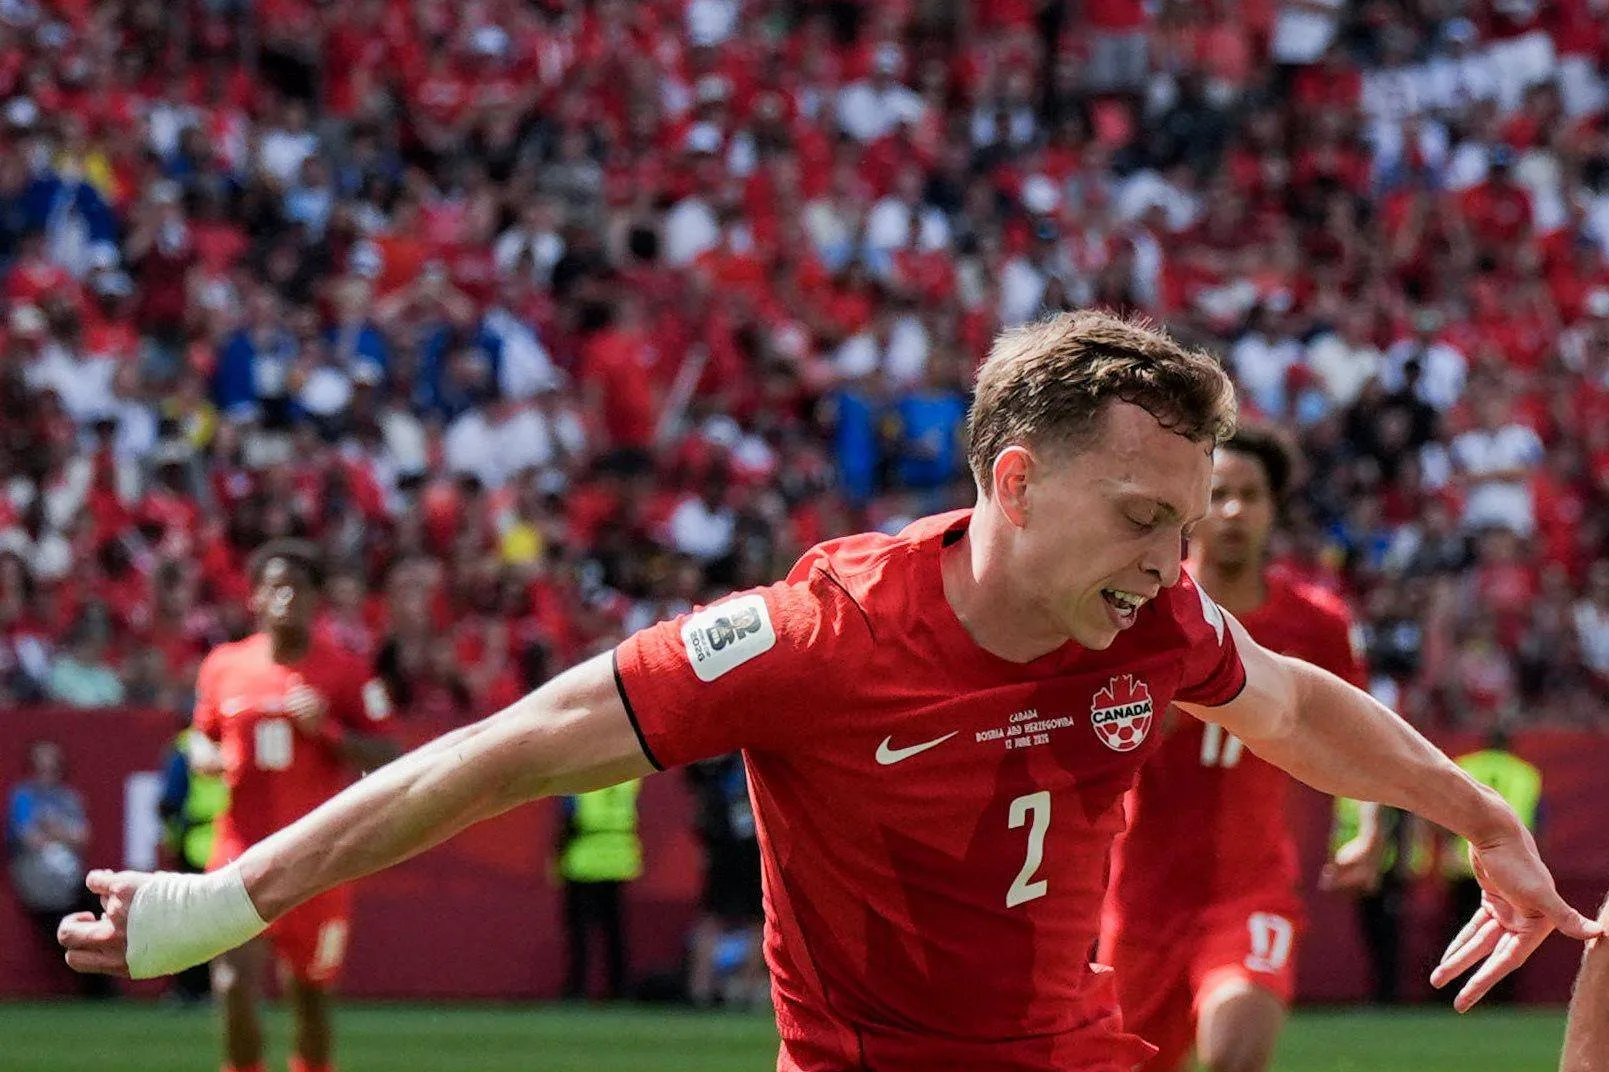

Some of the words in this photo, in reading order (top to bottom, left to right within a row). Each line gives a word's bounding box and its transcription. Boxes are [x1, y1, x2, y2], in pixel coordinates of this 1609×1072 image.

[1093, 703, 1151, 724] CANADA
[1006, 790, 1051, 909] 2
[1245, 911, 1293, 974] 17
